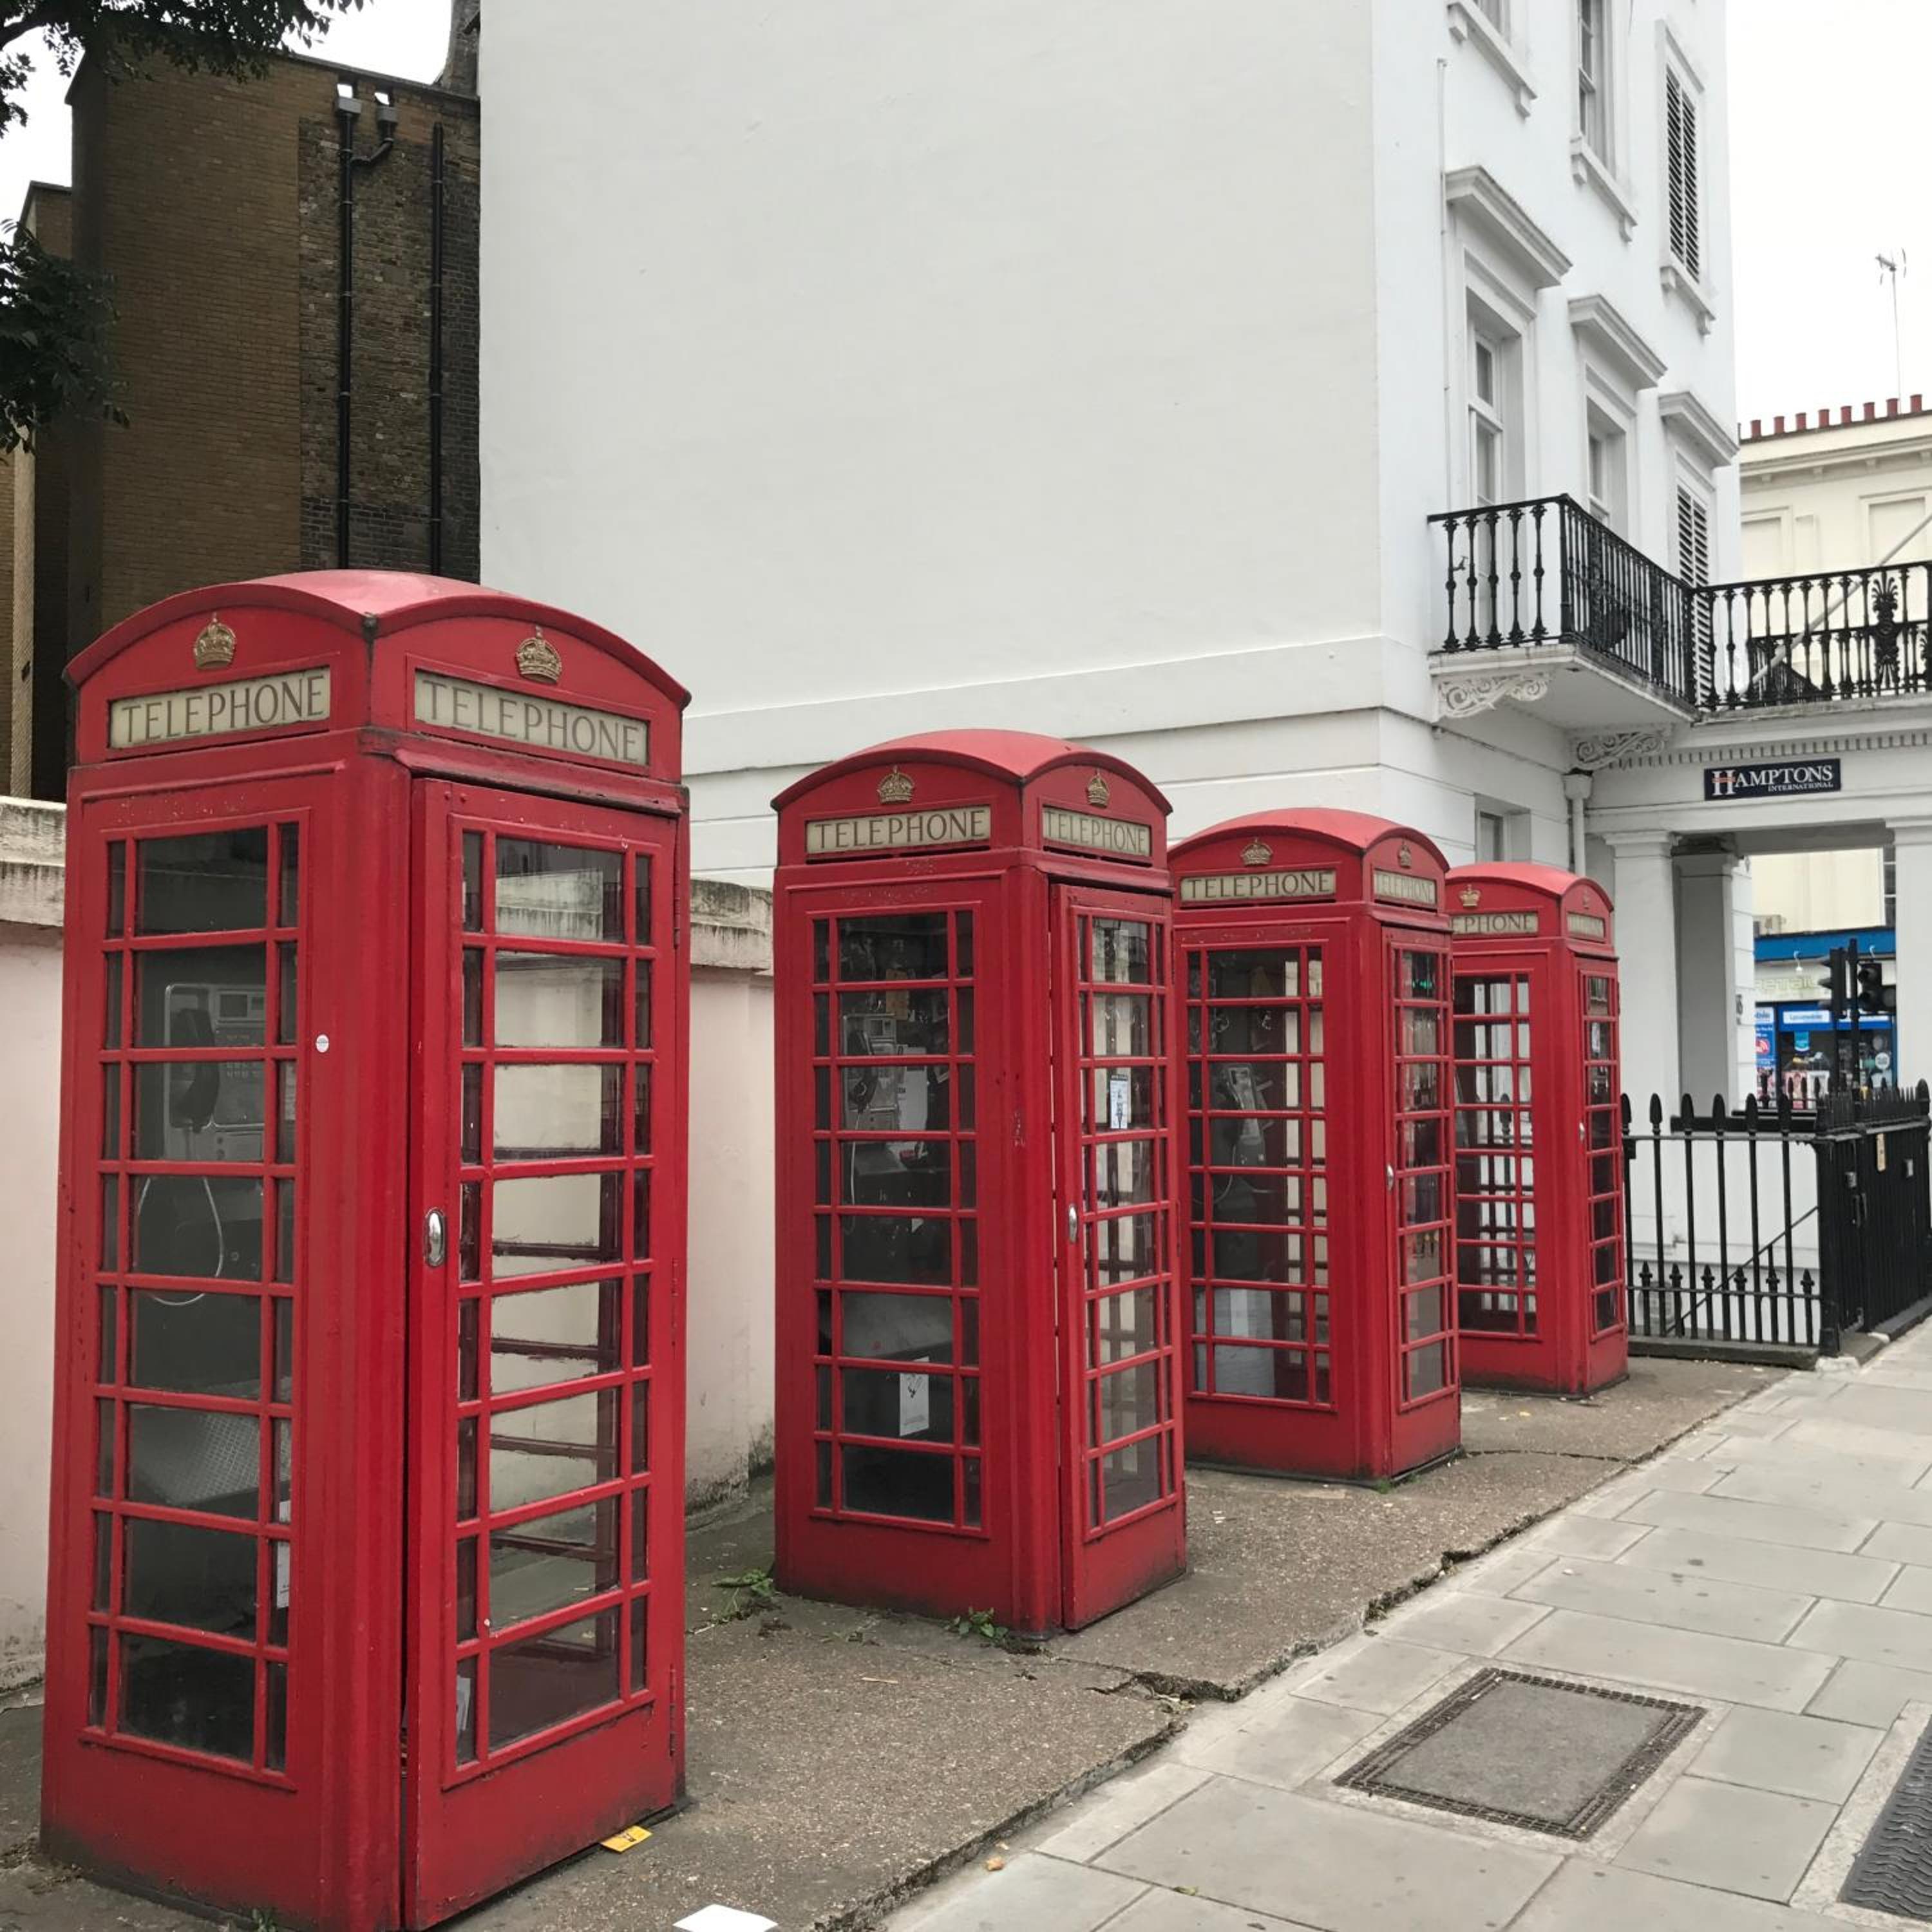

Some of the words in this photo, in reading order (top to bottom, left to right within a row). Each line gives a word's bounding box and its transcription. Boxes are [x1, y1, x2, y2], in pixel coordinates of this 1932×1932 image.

[122, 674, 324, 743] TELEPHONE
[424, 680, 638, 762] TELEPHONE
[1767, 782, 1833, 791] INTERNATIONAL
[815, 810, 985, 849] TELEPHONE
[1043, 810, 1146, 854] TELEPHONE
[1188, 871, 1330, 898] TELEPHONE
